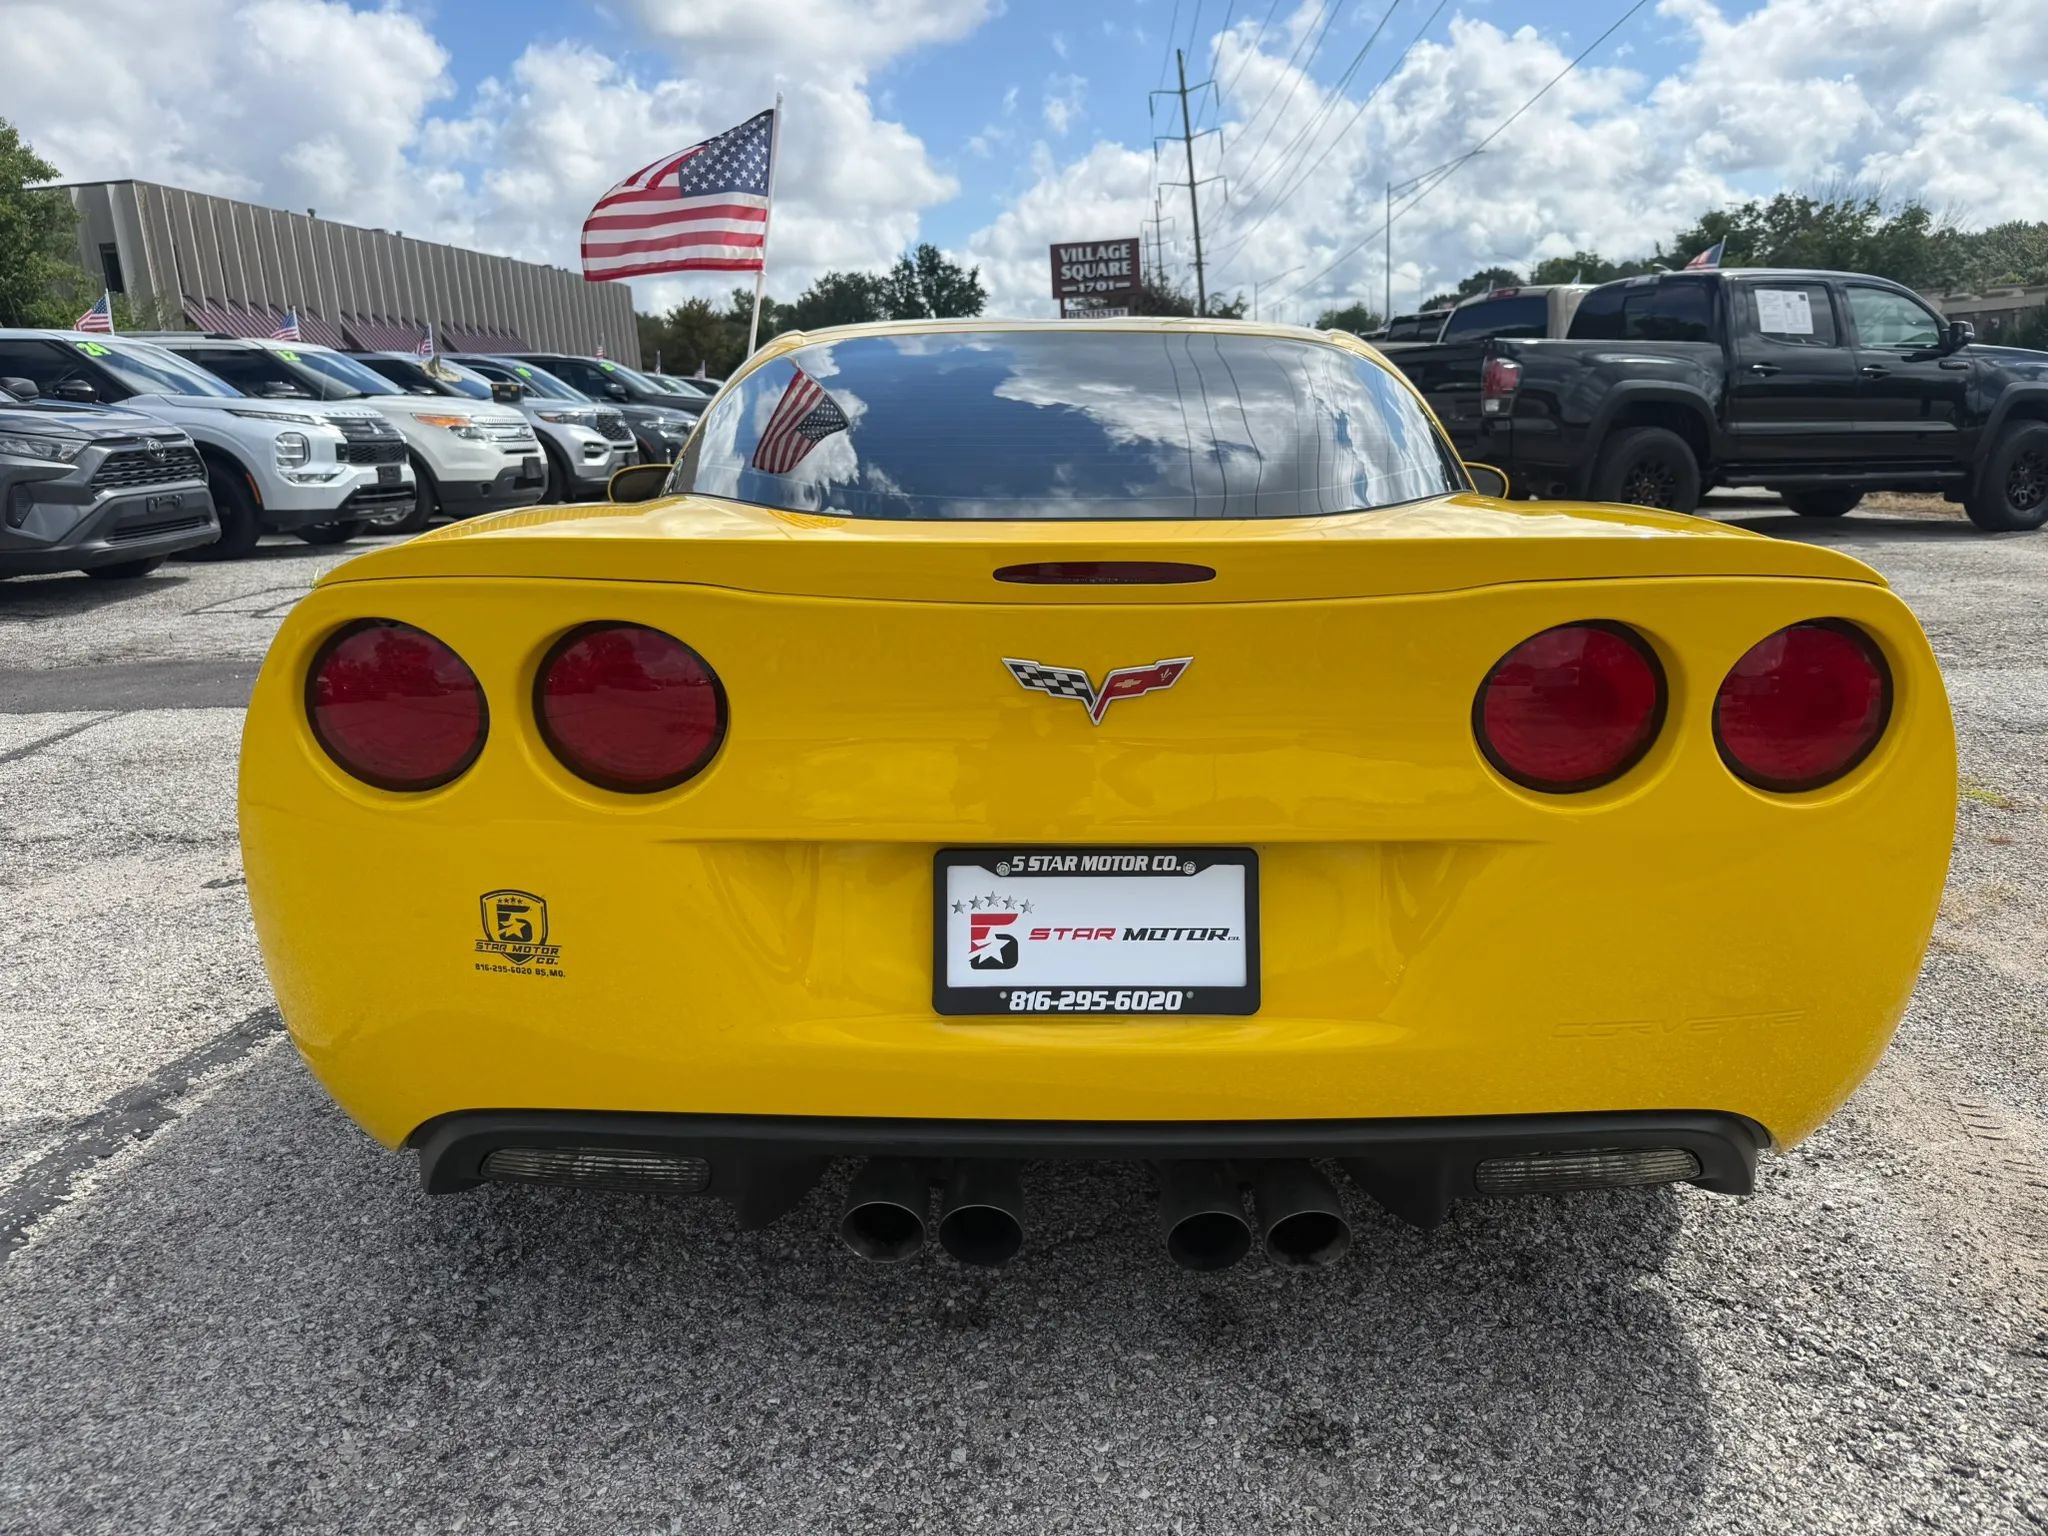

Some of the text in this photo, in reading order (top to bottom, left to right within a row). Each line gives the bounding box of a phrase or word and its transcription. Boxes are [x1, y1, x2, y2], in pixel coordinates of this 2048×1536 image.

[1059, 243, 1131, 262] VILLAGE
[1060, 261, 1132, 281] SQUARE
[1011, 855, 1182, 872] 5 STAR MOTOR CO.
[1028, 928, 1117, 941] STAR
[1122, 927, 1230, 941] MOTOR
[475, 942, 559, 955] STAR MOTOR
[536, 957, 559, 965] CO.
[1009, 990, 1183, 1011] 816-295-6020
